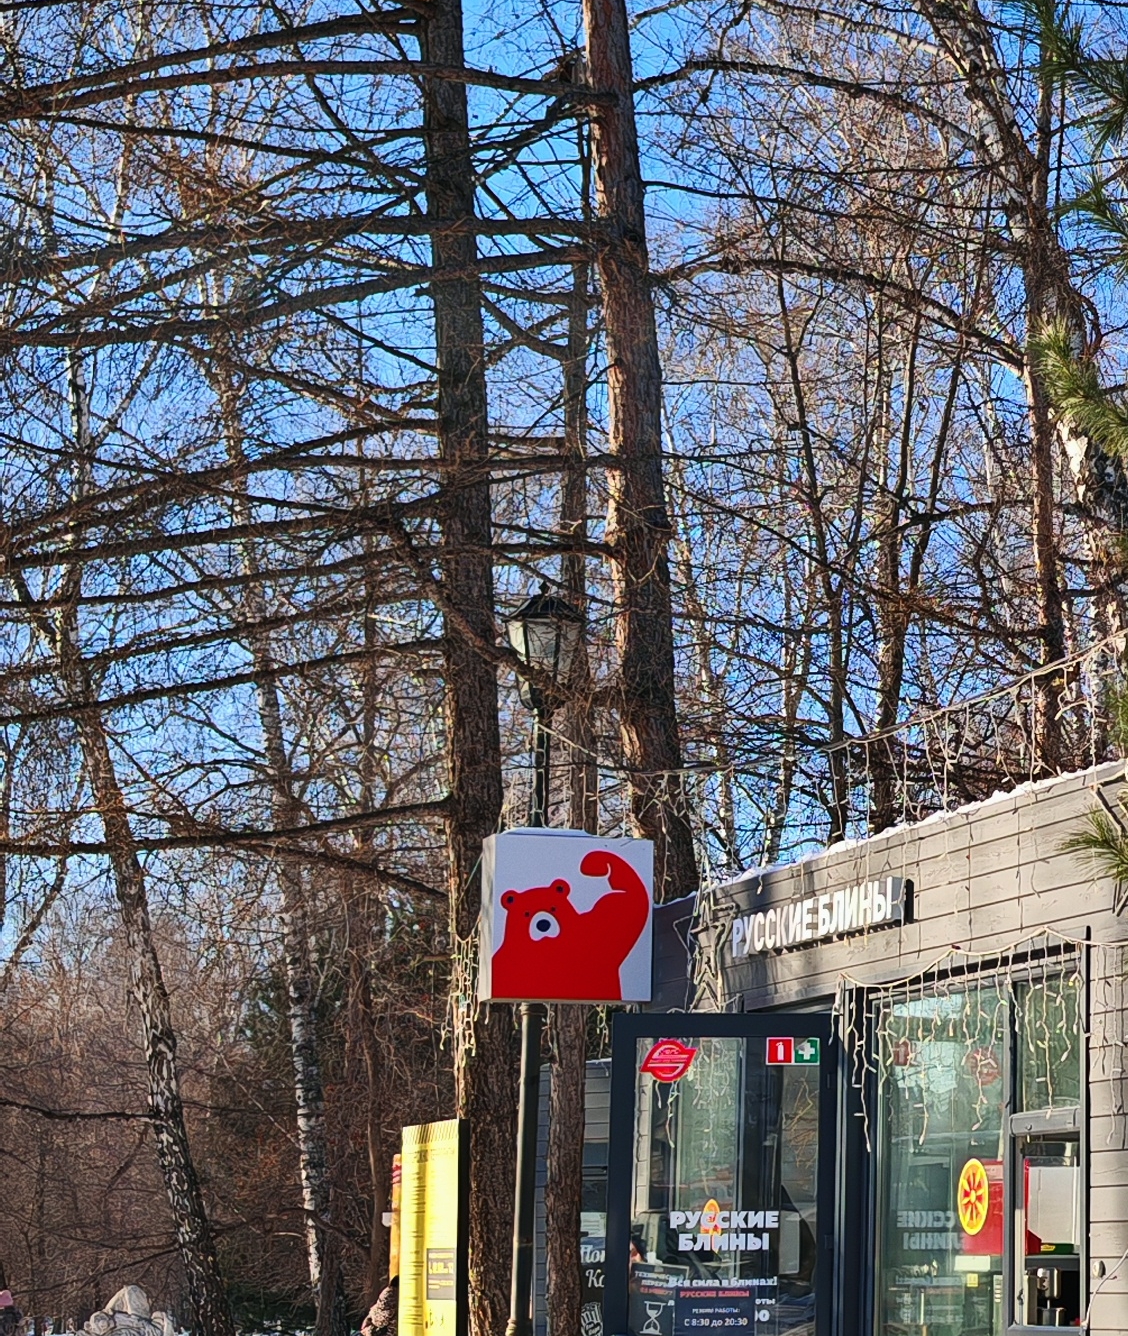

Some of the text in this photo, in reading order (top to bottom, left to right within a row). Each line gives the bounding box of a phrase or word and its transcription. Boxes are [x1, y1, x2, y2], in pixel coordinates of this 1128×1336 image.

[732, 876, 896, 958] РУССКИЕ БЛИНЫ
[669, 1210, 779, 1229] РУССКИЕ
[678, 1233, 769, 1251] БЛИНЫ
[692, 1279, 719, 1287] сила
[730, 1276, 778, 1288] блинах!
[680, 1290, 717, 1298] РУССКИЕ
[724, 1318, 748, 1326] 20:30
